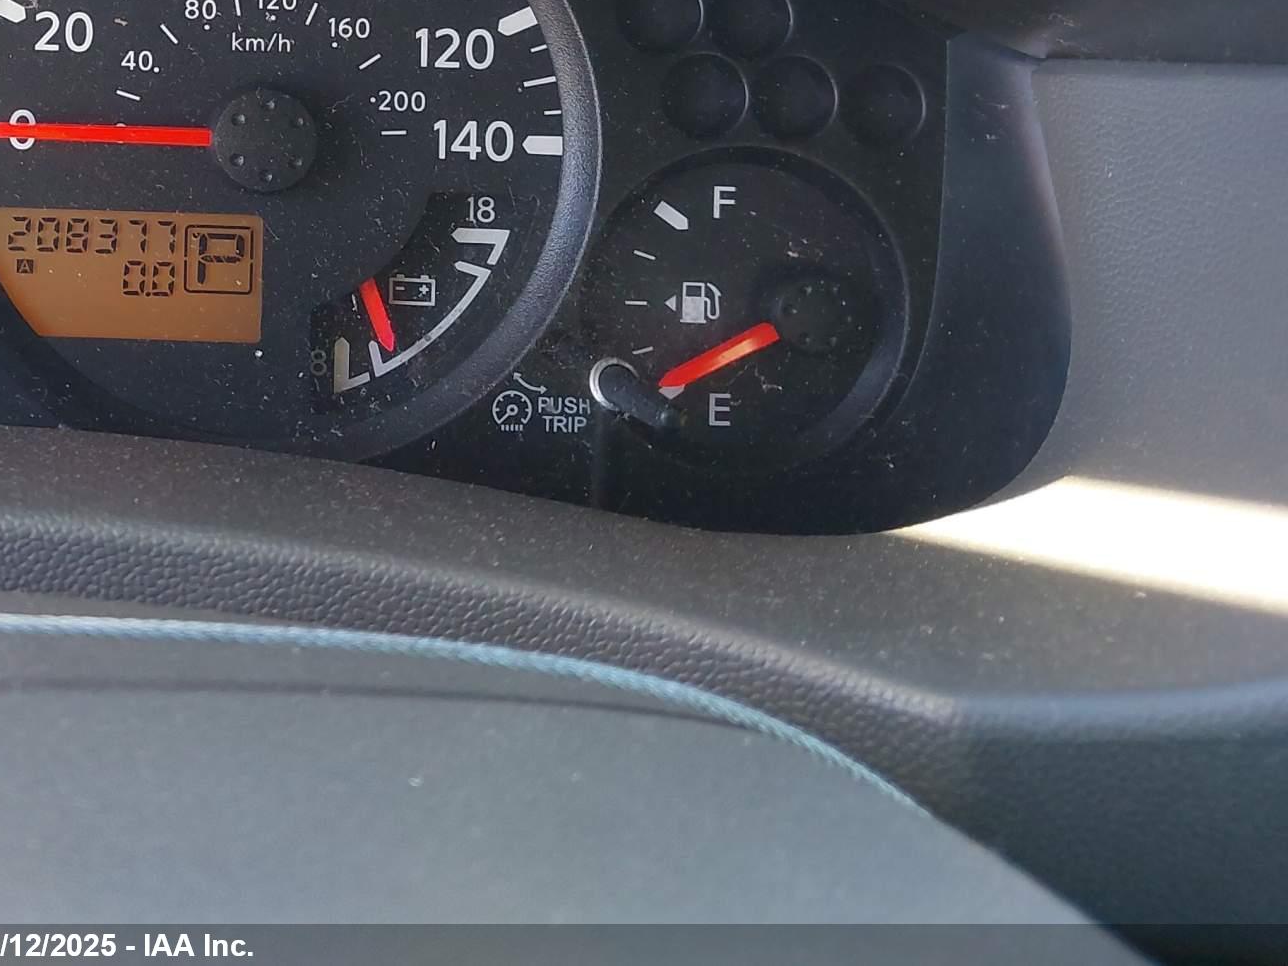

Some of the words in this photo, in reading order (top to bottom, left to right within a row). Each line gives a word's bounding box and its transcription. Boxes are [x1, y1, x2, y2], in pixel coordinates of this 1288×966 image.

[34, 11, 94, 53] 20
[231, 32, 292, 53] km/h
[329, 17, 370, 39] 160
[121, 50, 153, 71] 40
[415, 28, 495, 70] 120
[378, 90, 426, 112] 200
[9, 109, 36, 150] 0
[433, 119, 514, 162] 140
[466, 196, 495, 223] 18
[713, 185, 736, 219] F
[8, 216, 176, 254] 208377
[17, 260, 33, 273] A
[197, 233, 245, 285] P
[122, 260, 175, 297] 0.0
[310, 349, 328, 376] 8
[537, 396, 591, 414] PUSH
[708, 393, 731, 426] E
[541, 415, 587, 433] TRIP
